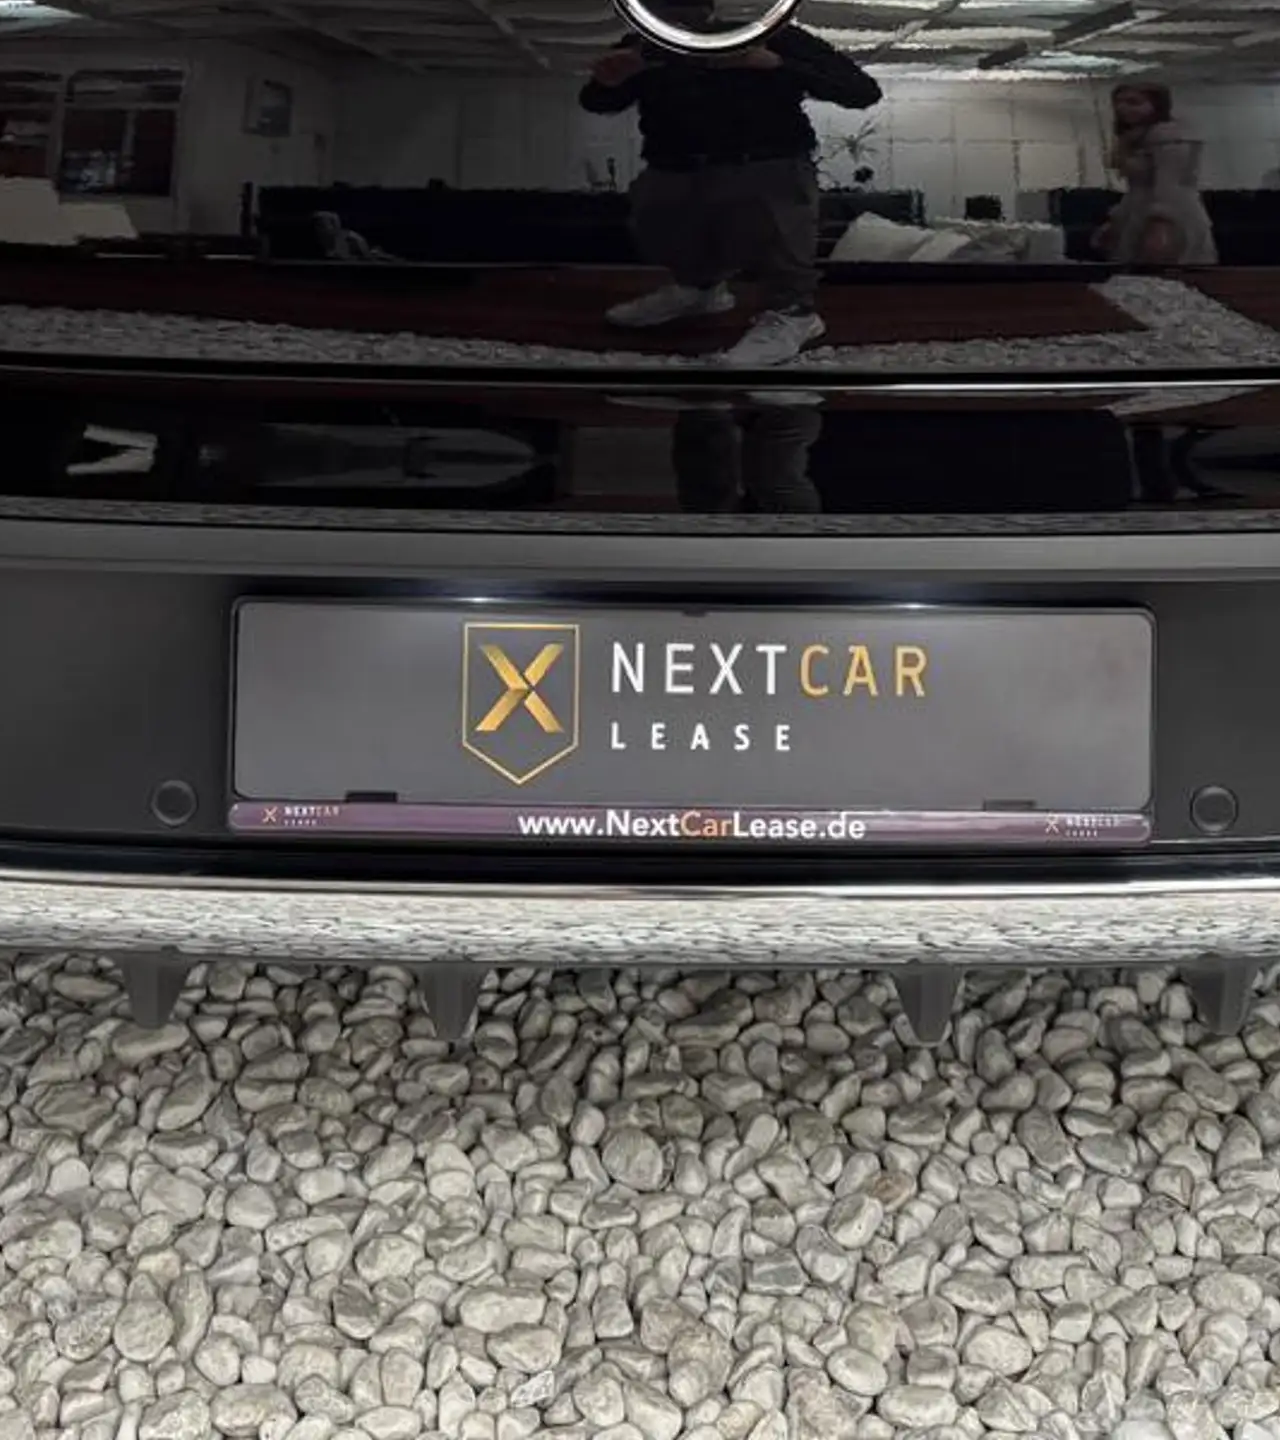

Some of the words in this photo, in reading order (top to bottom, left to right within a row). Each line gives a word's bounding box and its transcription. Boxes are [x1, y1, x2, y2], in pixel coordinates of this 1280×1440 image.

[611, 641, 928, 698] NEXTCAR
[610, 721, 791, 752] LEASE
[518, 809, 867, 840] www.NextCarLease.de
